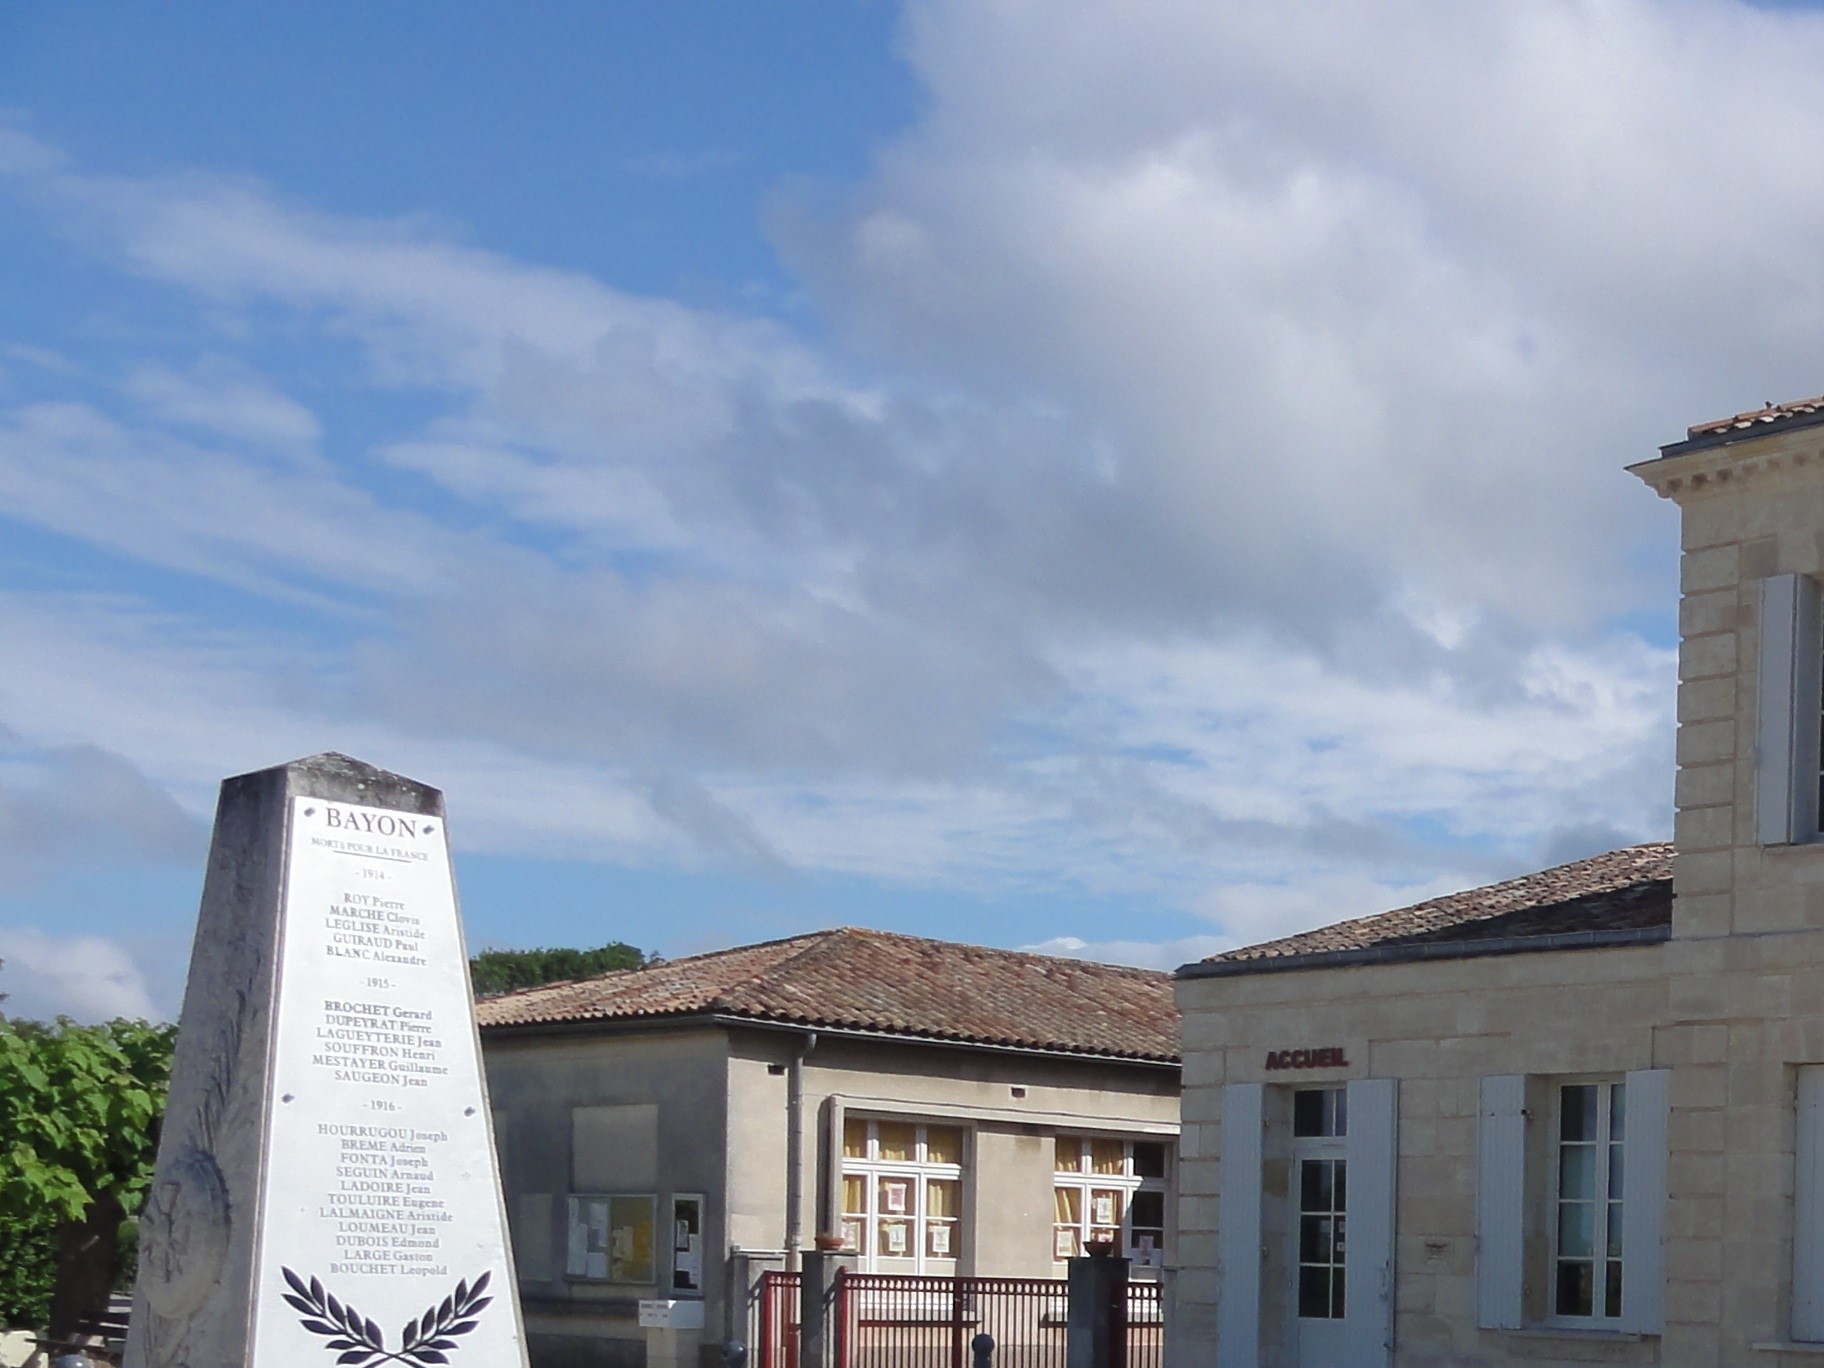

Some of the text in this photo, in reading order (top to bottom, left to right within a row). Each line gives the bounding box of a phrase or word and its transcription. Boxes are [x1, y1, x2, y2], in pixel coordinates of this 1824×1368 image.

[327, 807, 418, 839] BAYON
[376, 846, 388, 855] LA
[391, 849, 429, 861] FRANCE
[344, 893, 405, 910] ROY Pierre
[330, 905, 384, 921] MARCHE
[325, 917, 380, 933] LEGLISE
[333, 933, 418, 951] GUIRAUD Paul
[326, 945, 427, 966] BLANC Alexandre
[324, 1000, 390, 1016] BROCHET
[325, 1014, 398, 1030] DUPEYRAT
[316, 1027, 442, 1048] LAGUEYTERIE Jean
[325, 1042, 435, 1060] SOUFFRON Henri
[1265, 1047, 1350, 1070] ACCUEIL
[312, 1054, 449, 1075] MESTAYER Guillaume
[334, 1070, 428, 1087] SAUGEON Jean
[341, 1139, 387, 1152] BREME
[340, 1153, 388, 1165] FONTA
[336, 1167, 388, 1179] SEGUIN
[341, 1181, 431, 1194] LADOIRE Jean
[338, 1222, 436, 1235] LOUMEAU Jean
[336, 1236, 440, 1248] DUBOIS Edmond
[344, 1250, 391, 1261] LARGE
[330, 1263, 397, 1274] BOUCHET
